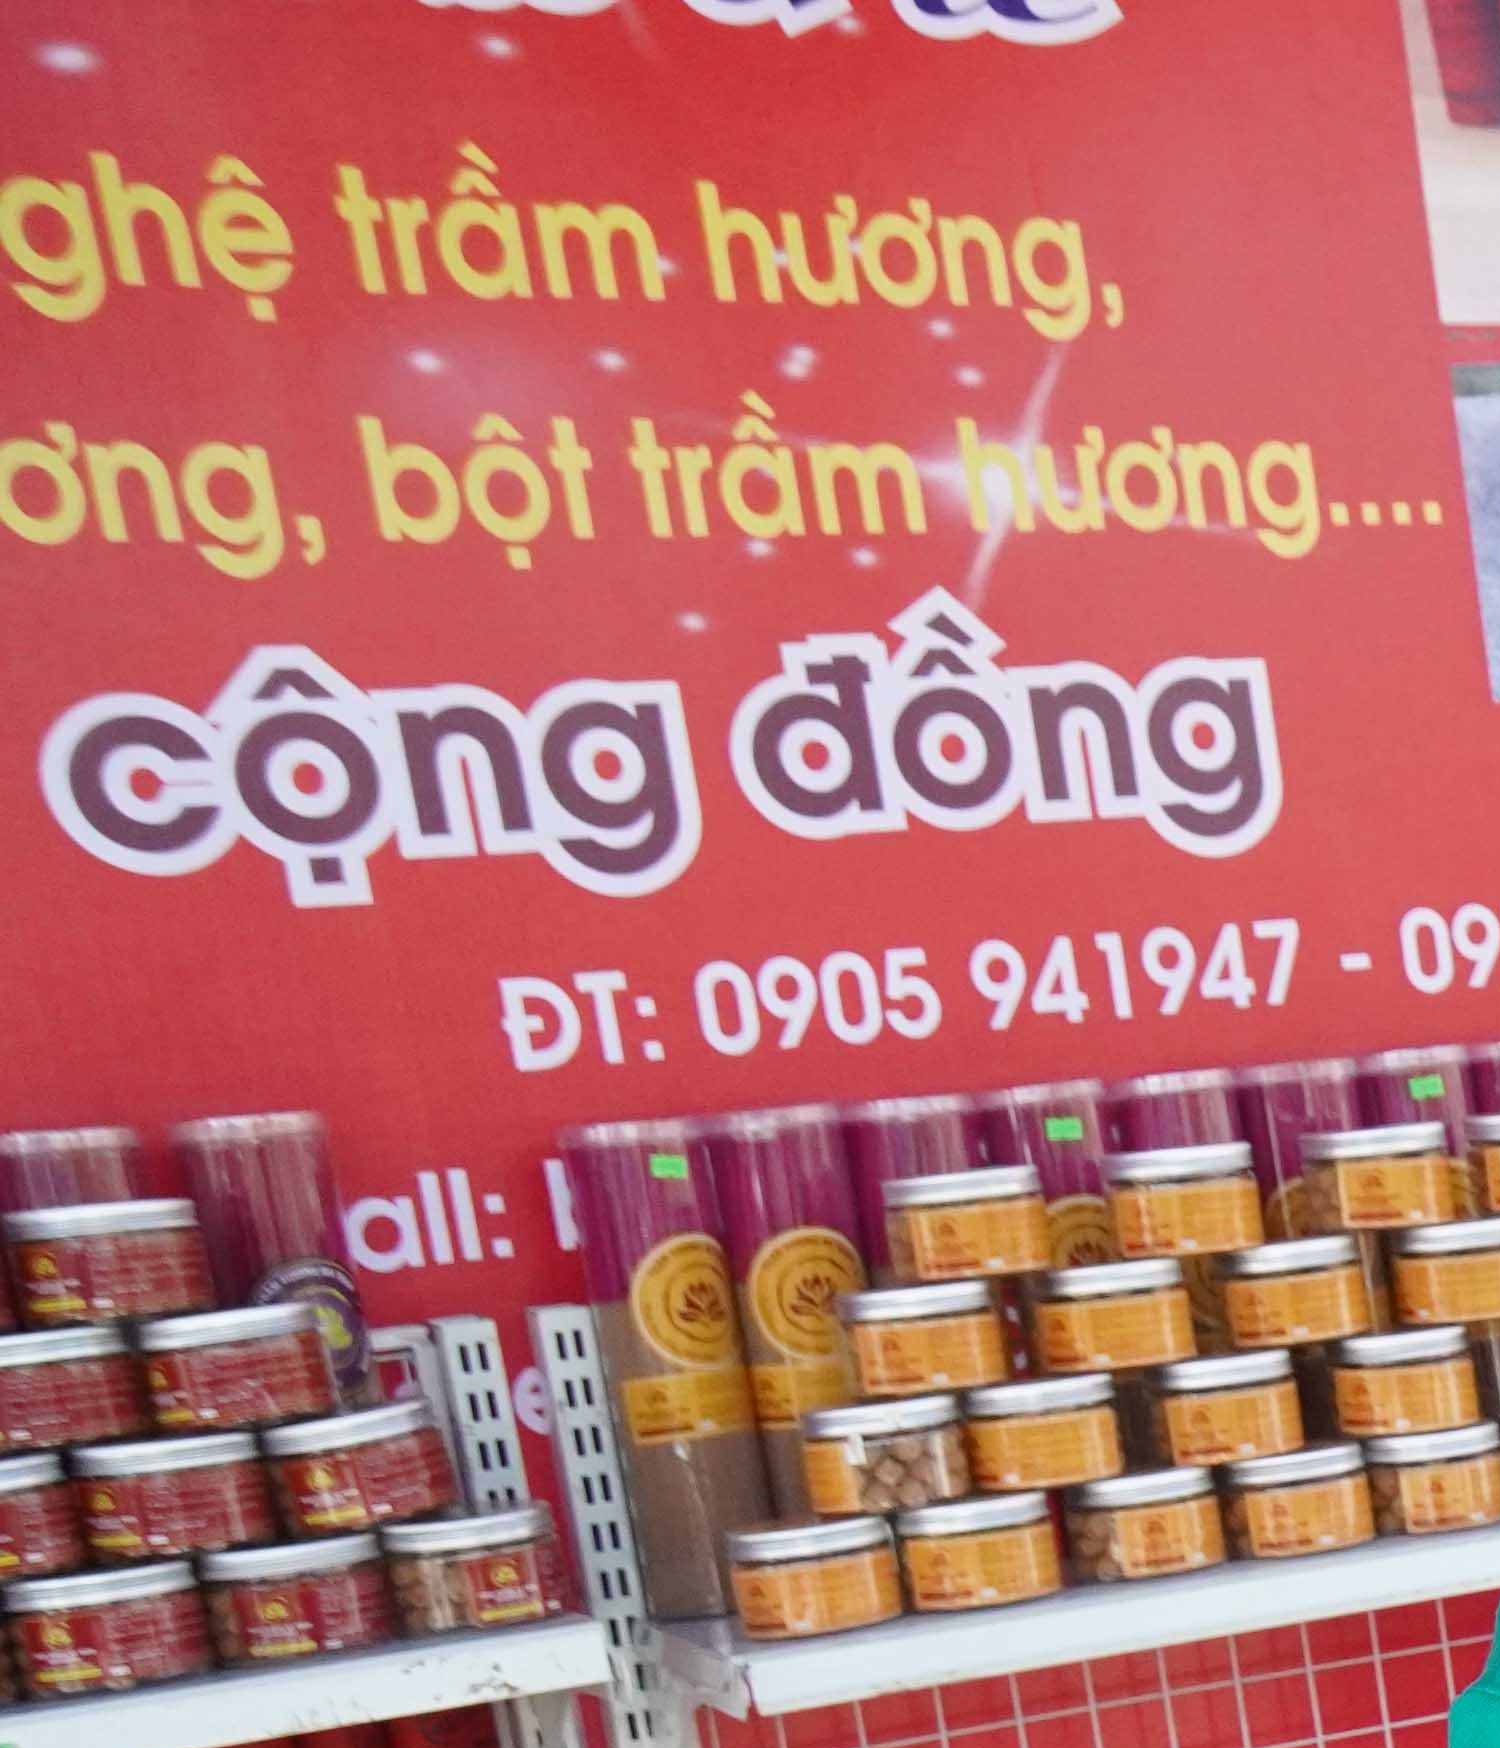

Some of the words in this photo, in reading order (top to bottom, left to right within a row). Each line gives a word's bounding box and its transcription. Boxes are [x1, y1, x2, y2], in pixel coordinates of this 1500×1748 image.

[0, 152, 294, 322] ghệ
[335, 140, 666, 302] trầm
[695, 181, 1124, 340] hương,
[0, 421, 325, 580] ơng,
[358, 414, 595, 571] bột
[630, 390, 927, 539] trầm
[956, 418, 1443, 558] hương....
[40, 646, 701, 907] cộng
[729, 585, 1283, 859] đồng
[498, 970, 666, 1072] ĐT:
[694, 947, 942, 1056] 0905
[970, 917, 1300, 1030] 941947
